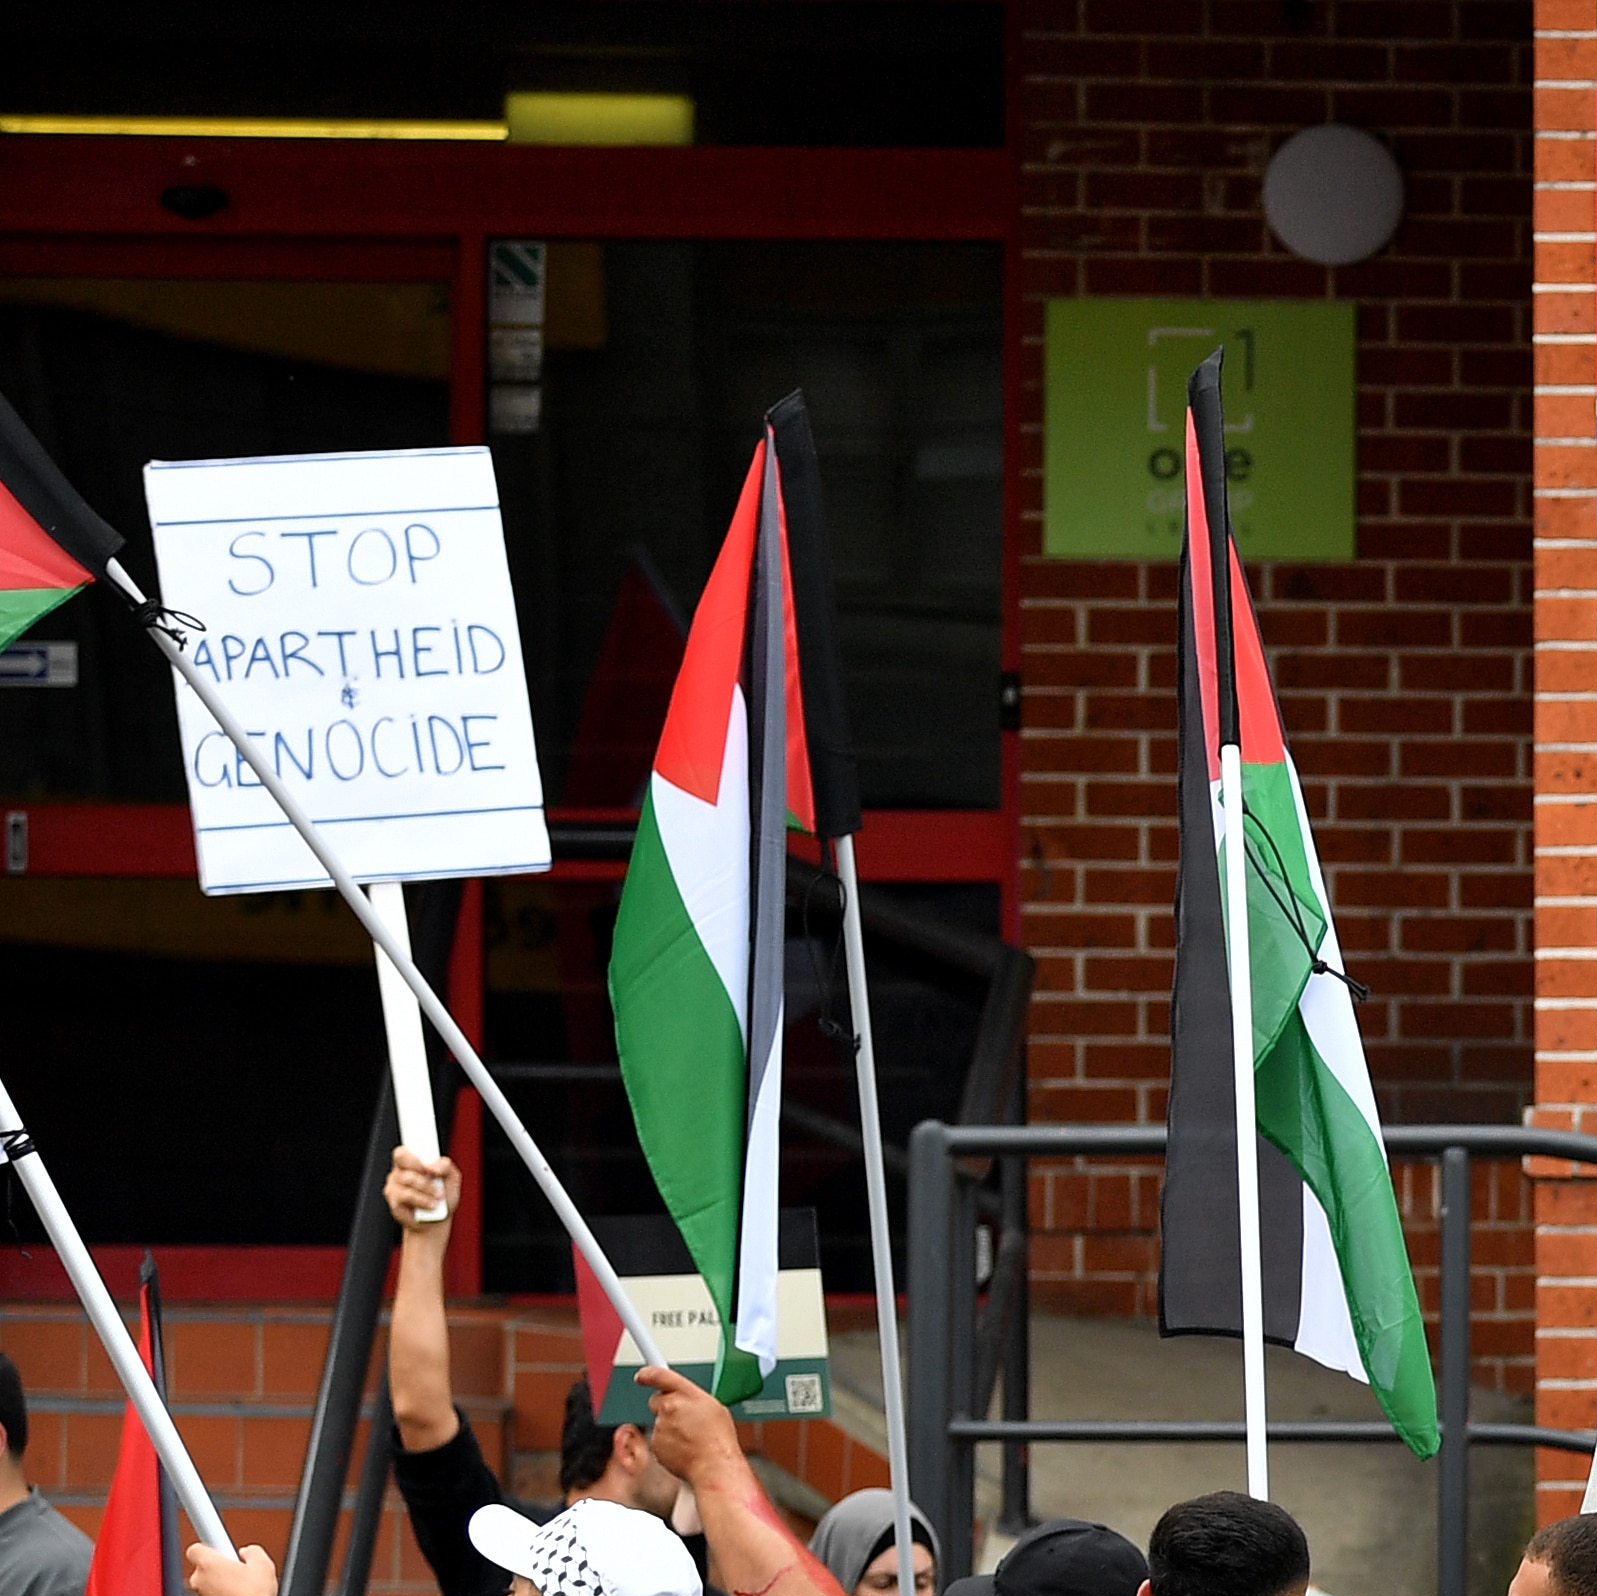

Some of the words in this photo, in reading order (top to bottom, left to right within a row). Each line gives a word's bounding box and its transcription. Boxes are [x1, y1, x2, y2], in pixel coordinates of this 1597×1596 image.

[1148, 448, 1252, 480] oe
[228, 523, 441, 596] STOP
[186, 619, 506, 684] APARTHEID
[194, 714, 506, 790] GENOCIDE
[652, 1311, 682, 1327] FREE
